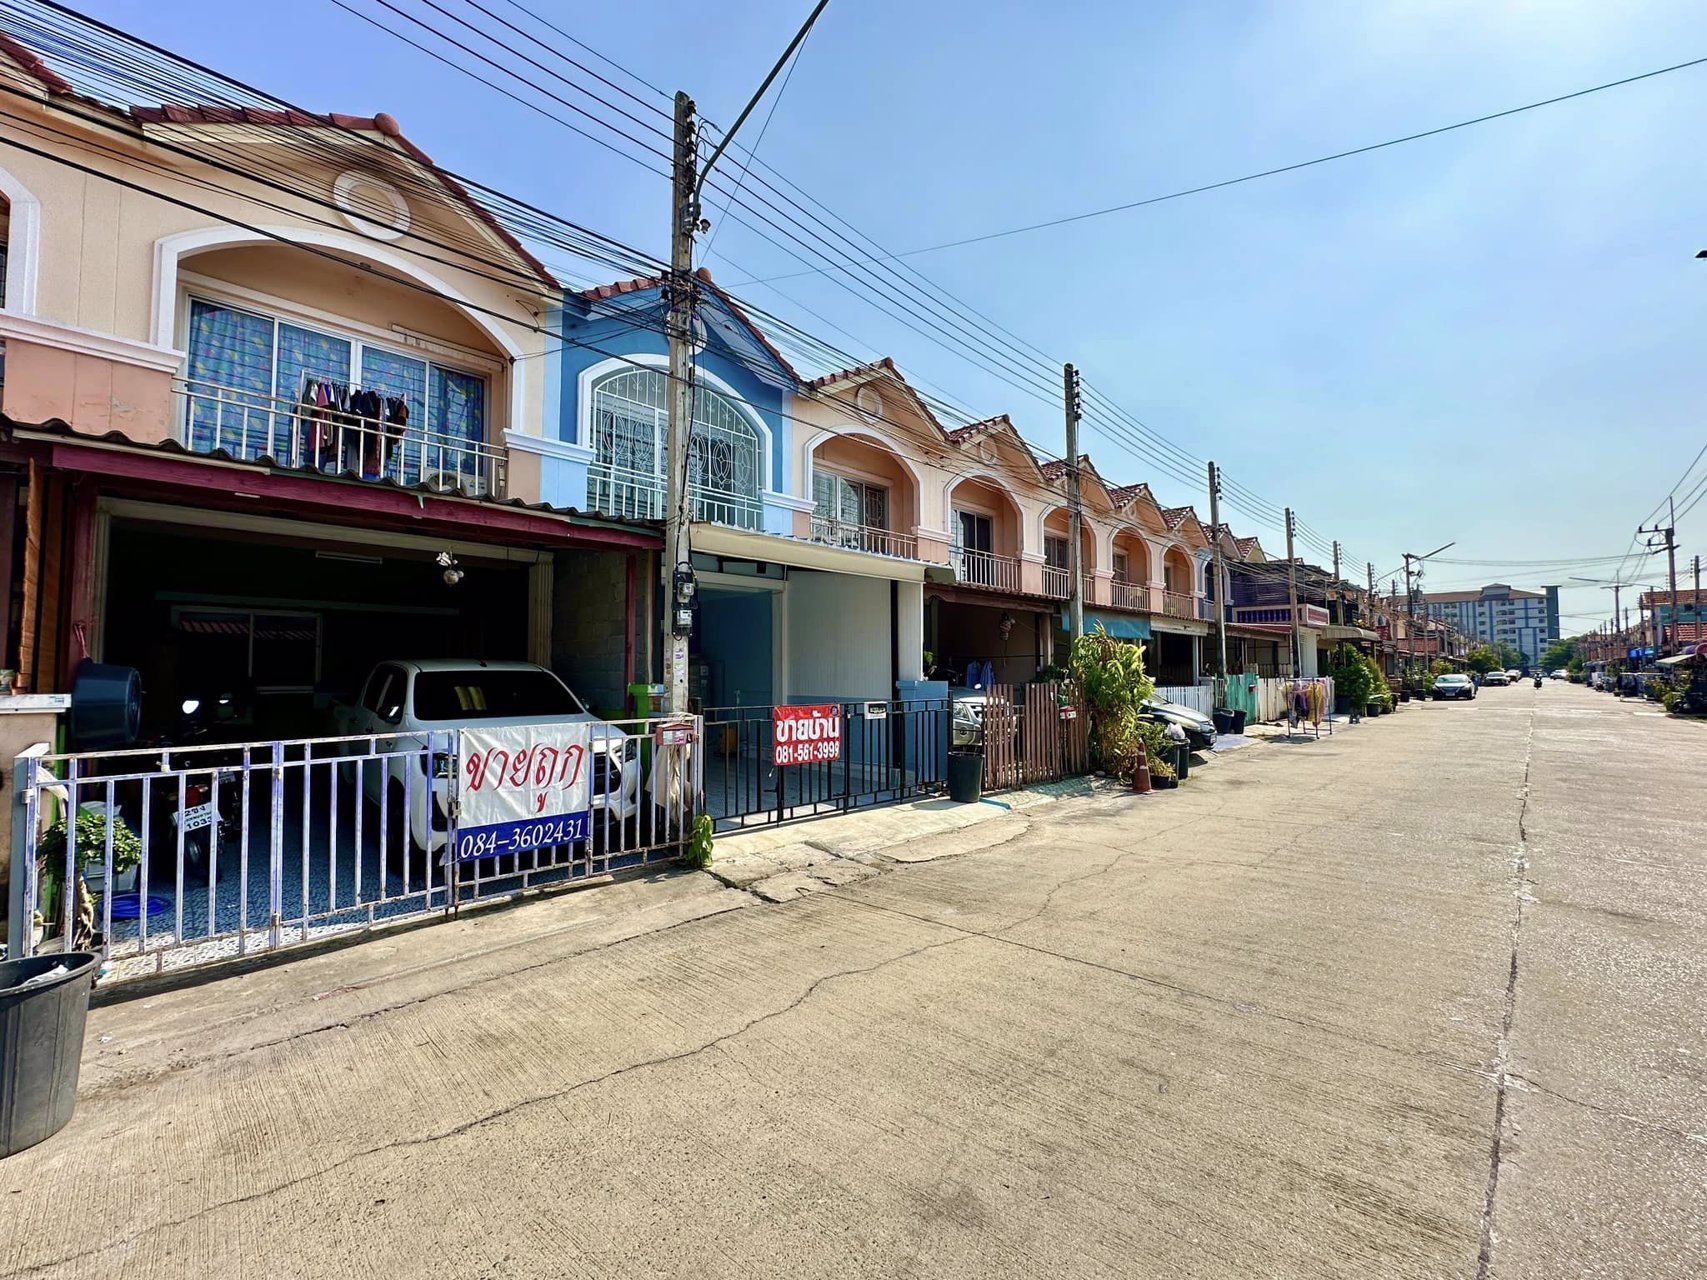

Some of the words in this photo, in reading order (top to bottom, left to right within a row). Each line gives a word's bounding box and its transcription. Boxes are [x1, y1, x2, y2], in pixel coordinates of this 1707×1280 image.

[776, 710, 840, 742] ขายบ้าน
[775, 741, 840, 763] 081-561-3999
[465, 742, 585, 814] ขายถูก
[460, 818, 583, 859] 084-3602431
